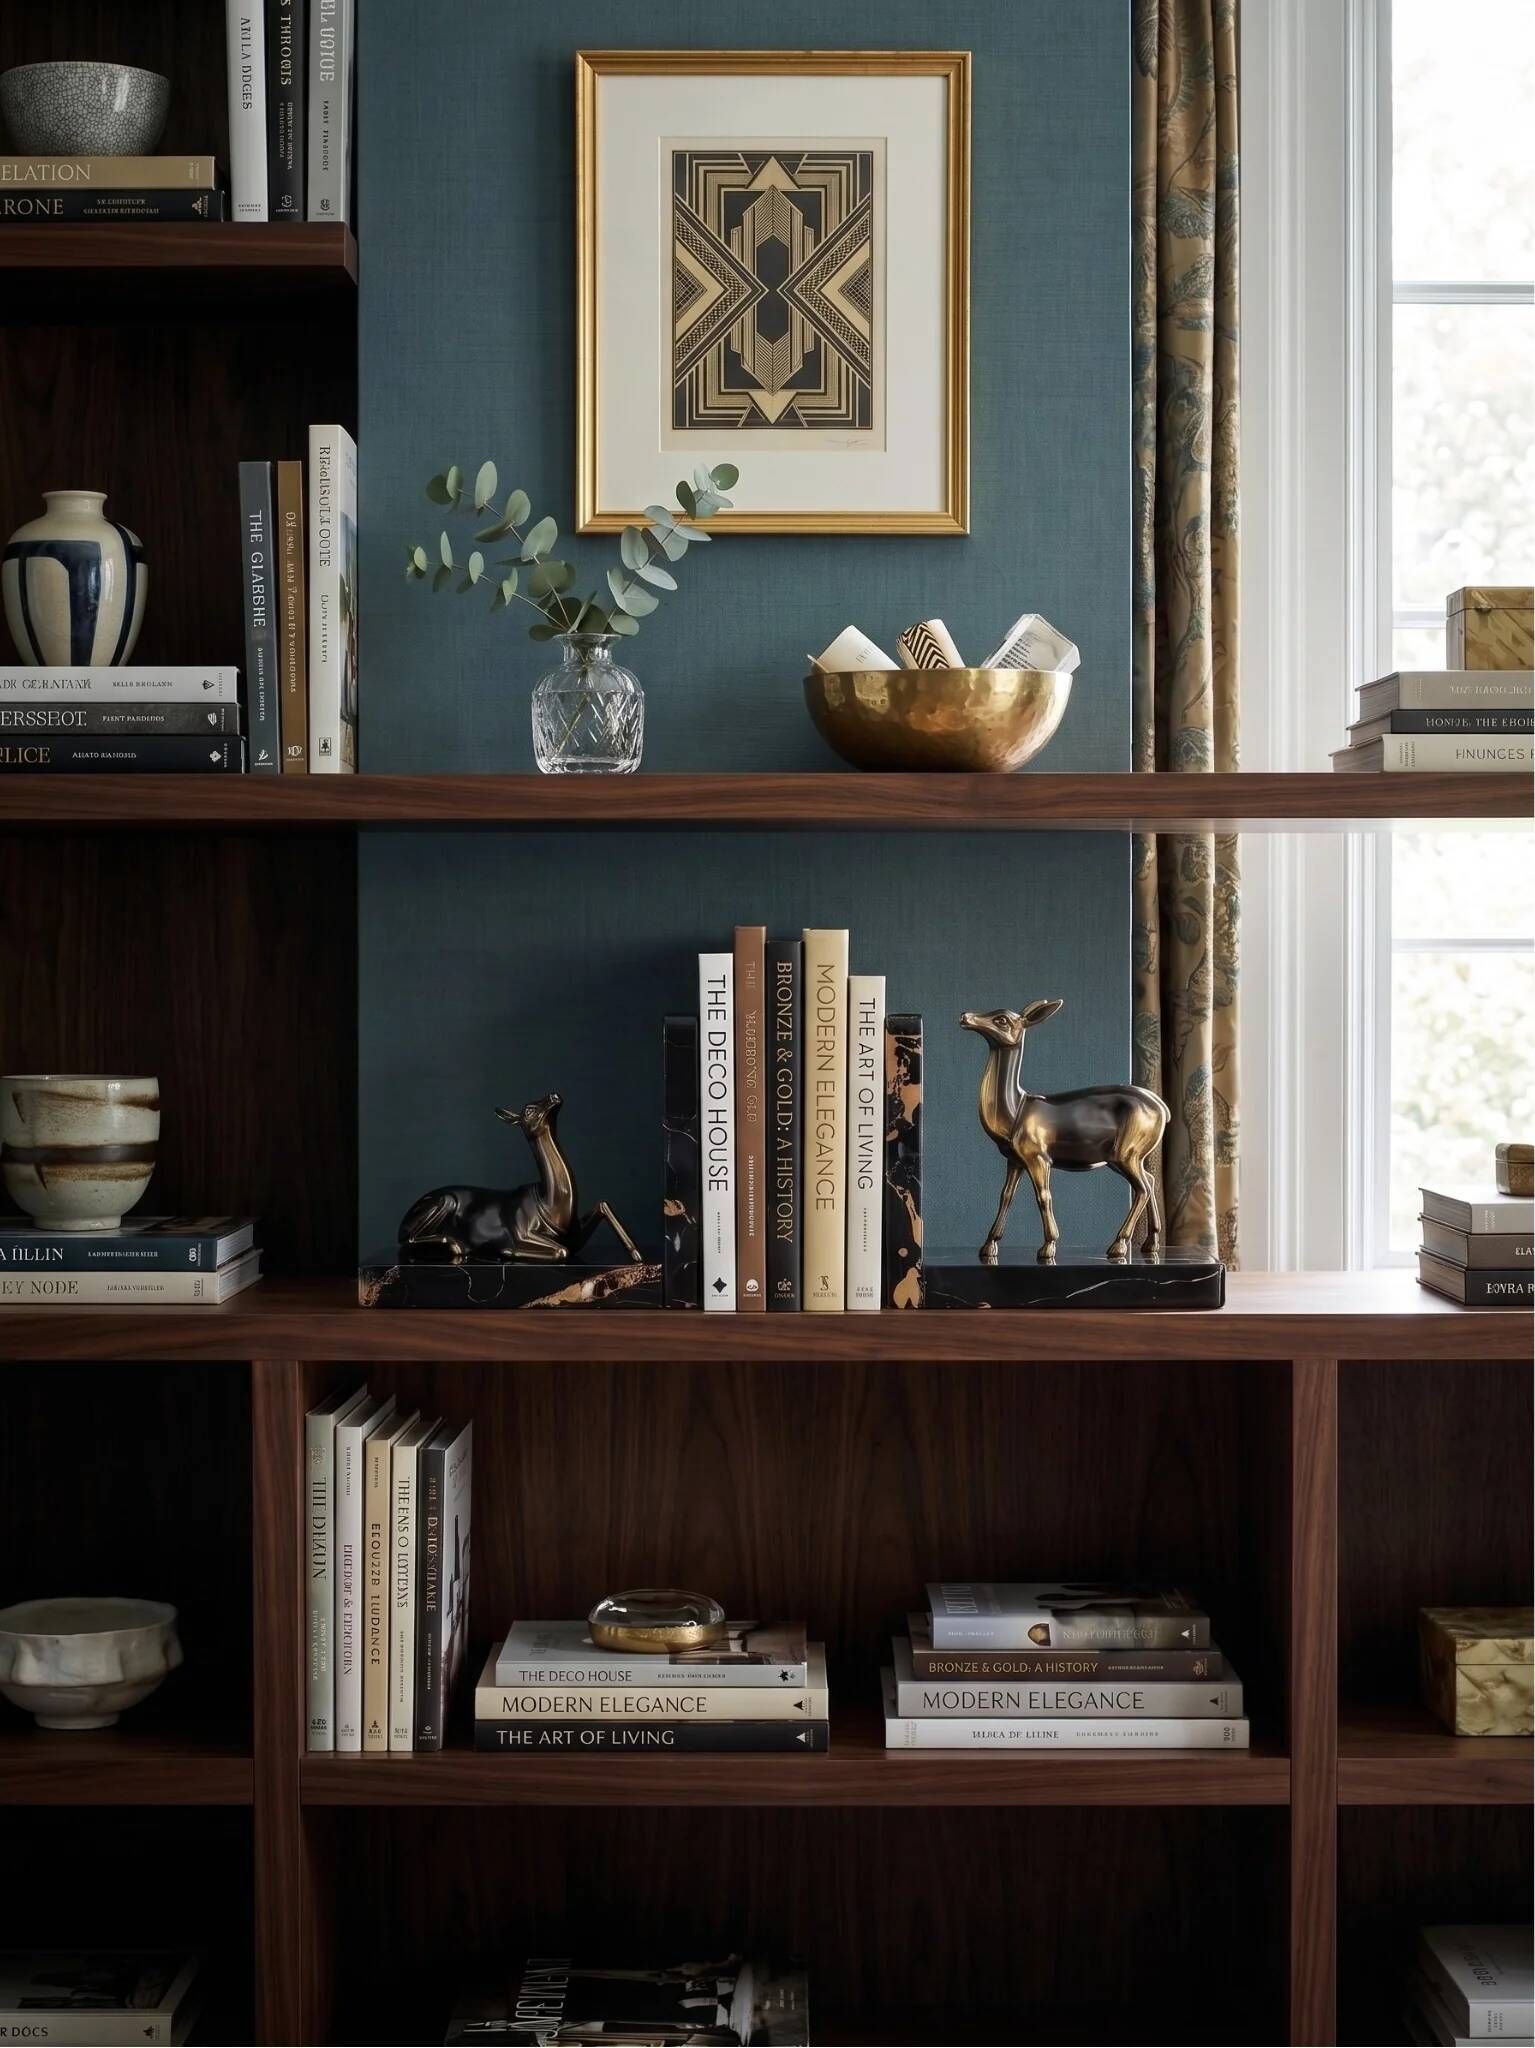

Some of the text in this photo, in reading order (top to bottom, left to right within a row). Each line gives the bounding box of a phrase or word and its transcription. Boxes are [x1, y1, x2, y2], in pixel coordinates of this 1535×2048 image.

[1, 166, 91, 181] ELATION
[0, 198, 64, 215] RONE
[249, 509, 263, 543] THE
[1475, 718, 1498, 728] THE
[707, 974, 729, 1192] THE DECO HOUSE
[815, 964, 836, 1211] MODERN ELEGANCE
[857, 998, 876, 1190] THE ART OF LIVING
[776, 962, 794, 1243] BRONZE & GOLD: A HISTORY
[31, 1281, 79, 1295] NODE
[929, 1662, 979, 1674] BRONZE
[982, 1663, 990, 1673] &
[1034, 1663, 1044, 1673] A
[1046, 1662, 1098, 1674] HISTORY
[519, 1671, 632, 1683] THE DECO HOUSE
[502, 1697, 707, 1713] MODERN ELEGANCE
[924, 1692, 1144, 1710] MODERN ELEGANCE
[496, 1731, 674, 1745] THE ART OF LIVING
